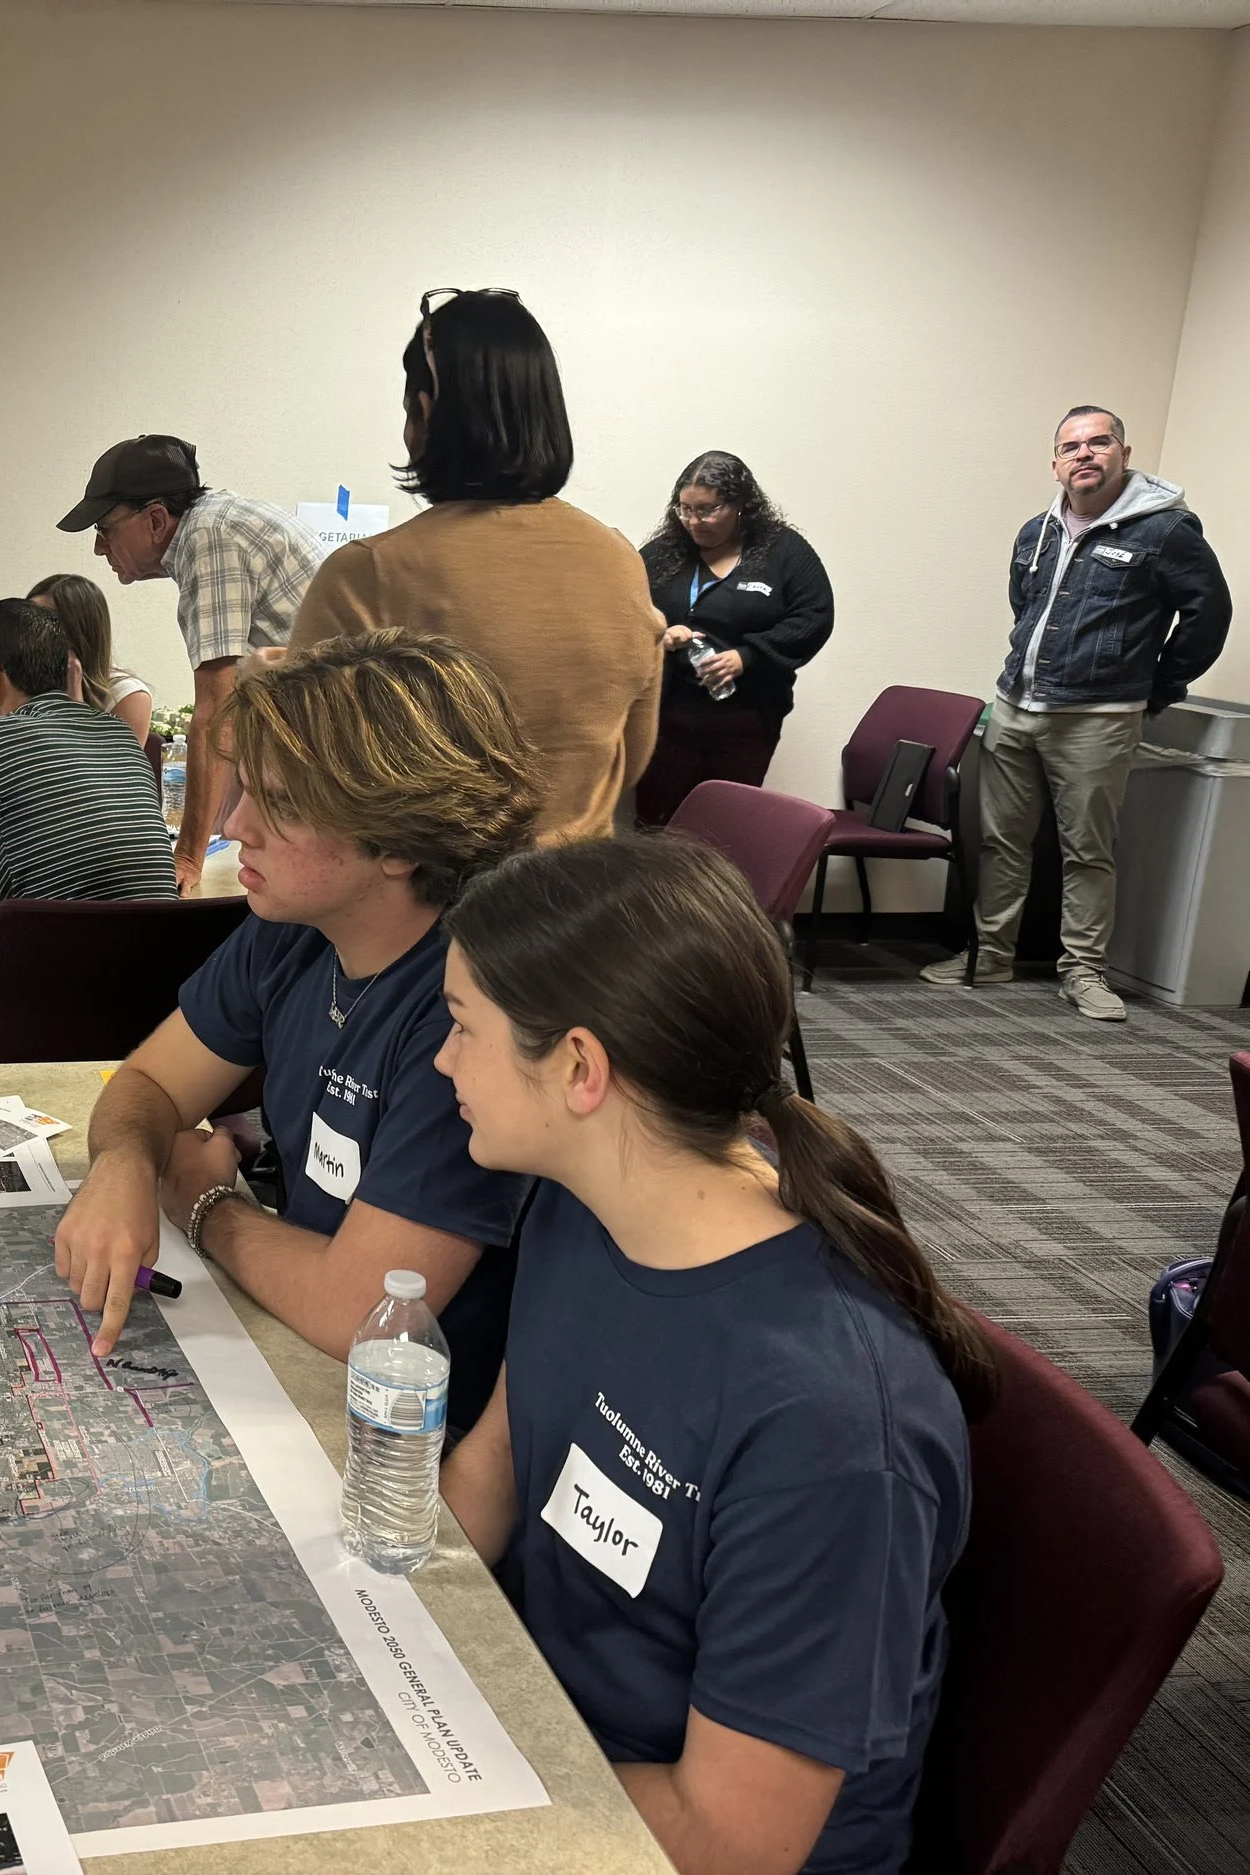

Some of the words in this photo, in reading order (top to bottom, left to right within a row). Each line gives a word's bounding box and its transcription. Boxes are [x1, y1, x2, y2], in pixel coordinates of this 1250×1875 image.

[313, 1141, 344, 1178] Martin
[594, 1391, 646, 1458] Tuolumne
[644, 1450, 681, 1490] River
[618, 1444, 642, 1477] Est.
[642, 1468, 672, 1500] 1981
[573, 1483, 639, 1557] Taylor
[354, 1588, 390, 1635] MODESTO
[383, 1635, 407, 1660] 2050
[398, 1660, 435, 1708] GENERAL
[427, 1708, 451, 1738] PLAN
[446, 1739, 483, 1783] UPDATE
[397, 1690, 419, 1713] CITY
[411, 1713, 429, 1731] OF
[421, 1731, 461, 1785] MODESTO
